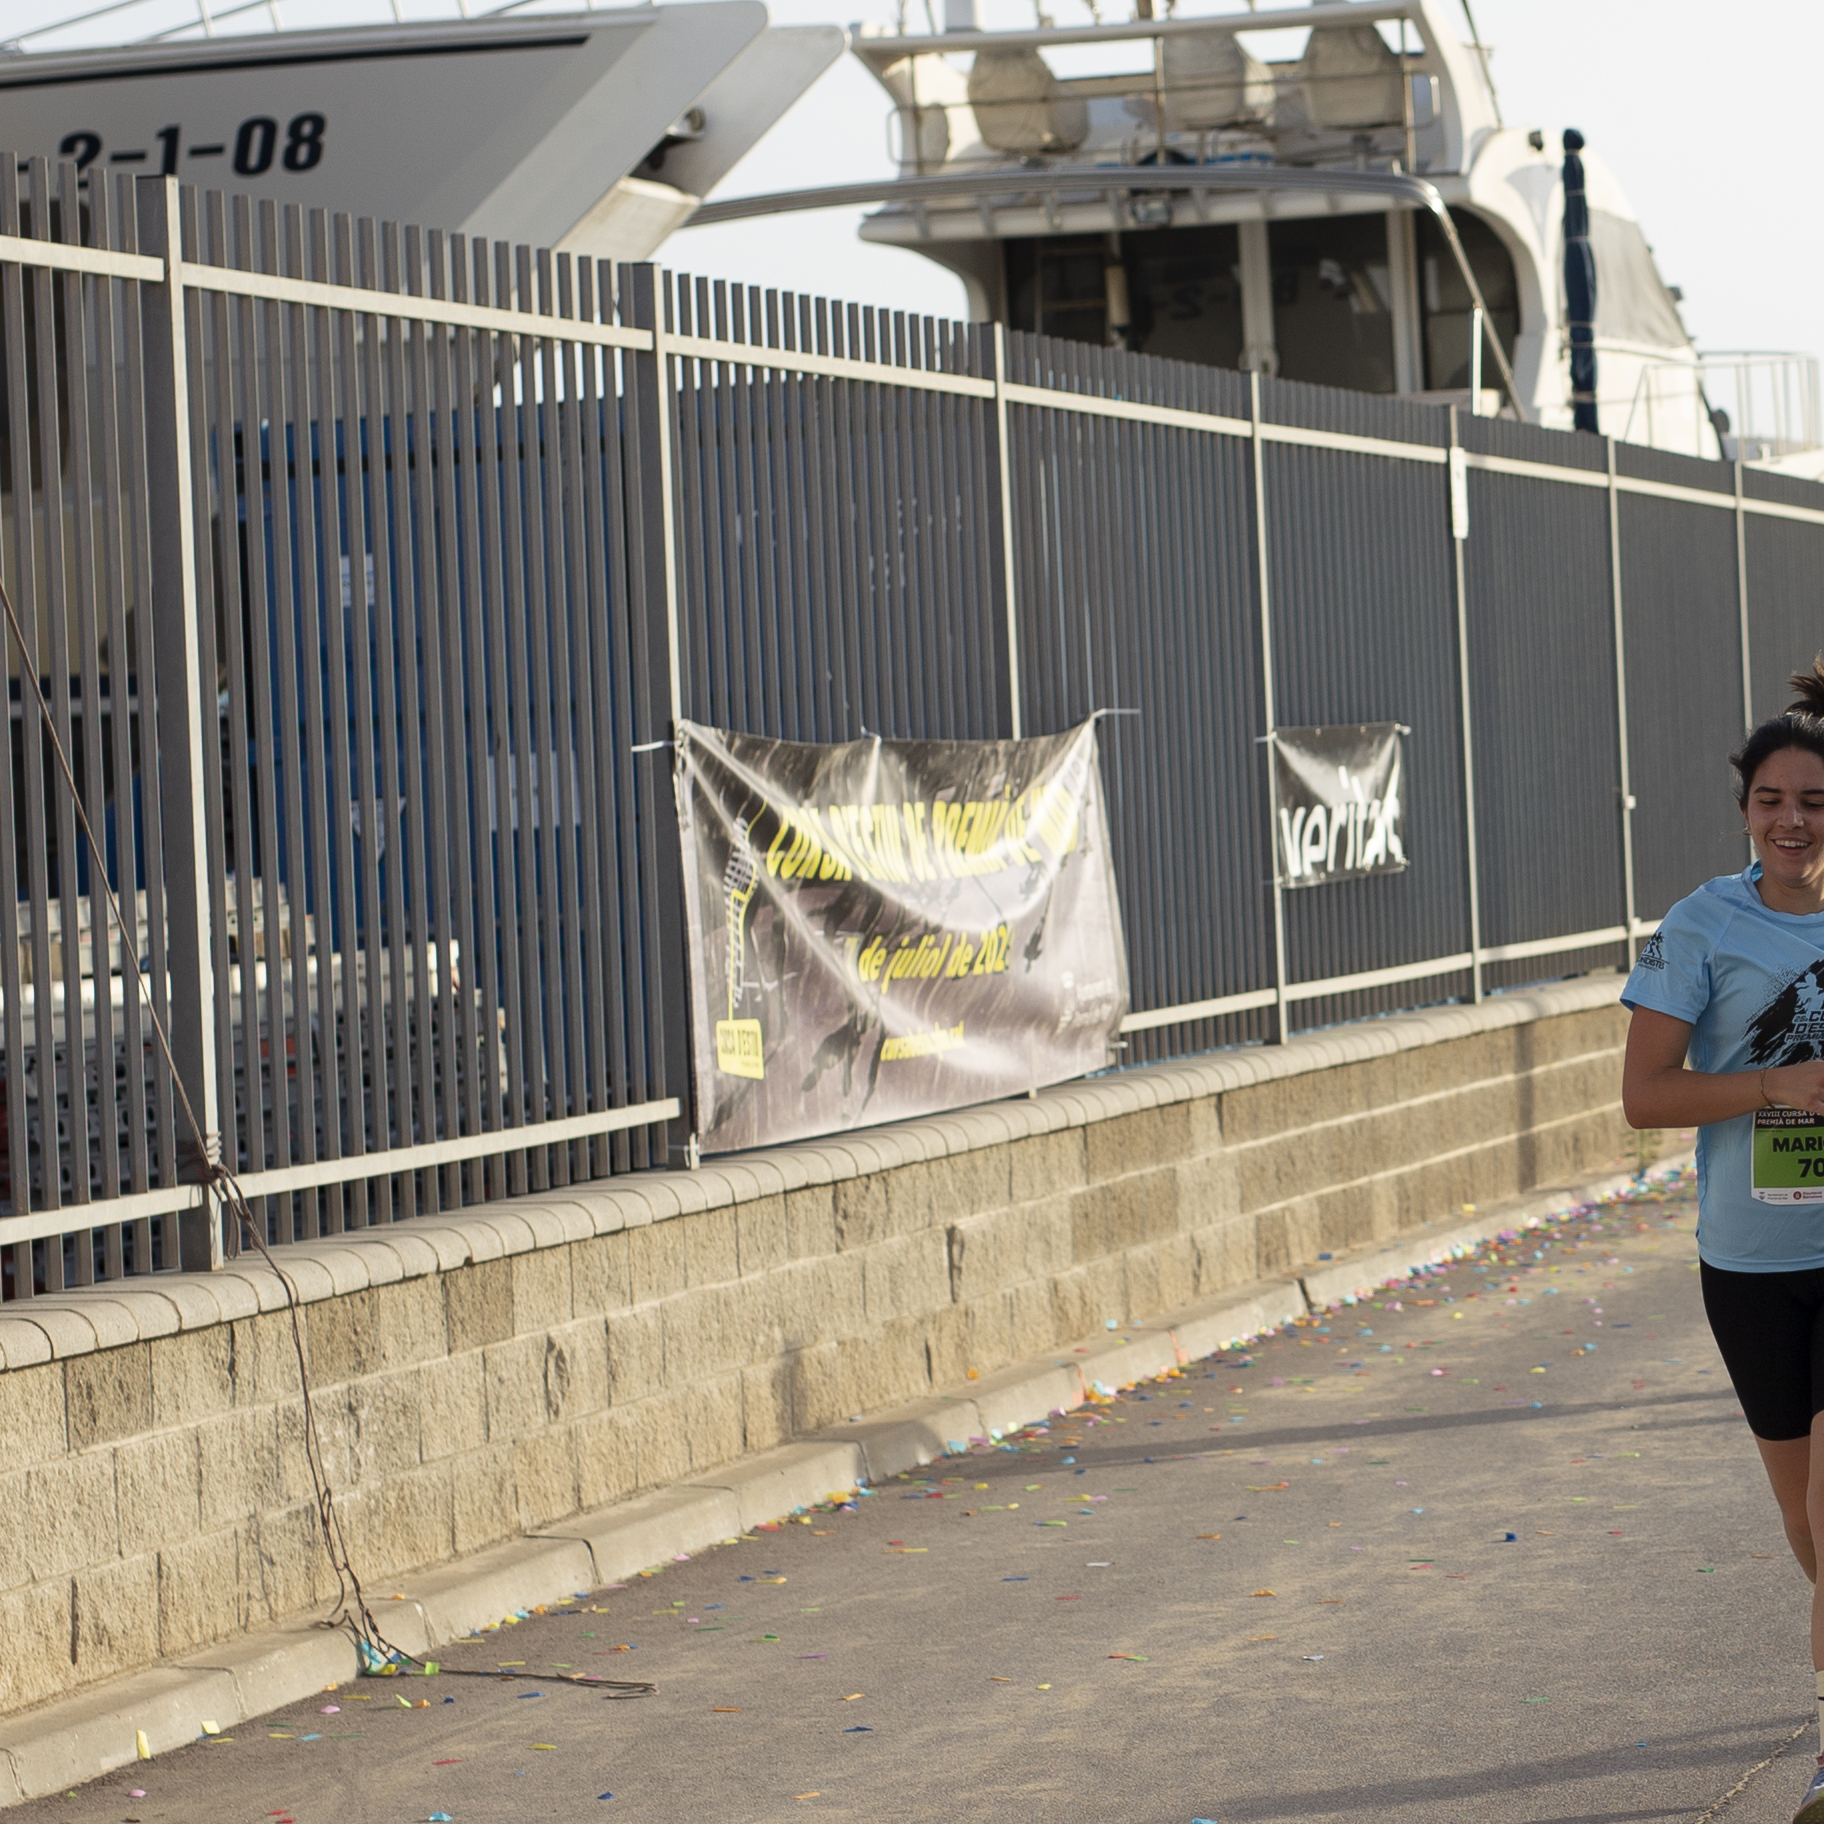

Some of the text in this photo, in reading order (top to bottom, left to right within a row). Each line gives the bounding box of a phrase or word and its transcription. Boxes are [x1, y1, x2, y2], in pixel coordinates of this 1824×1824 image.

[859, 935, 888, 982] de
[881, 933, 952, 994] juliol
[946, 931, 973, 977] de
[973, 924, 1014, 976] 202
[1786, 1117, 1796, 1125] DE
[1798, 1117, 1815, 1125] MAR
